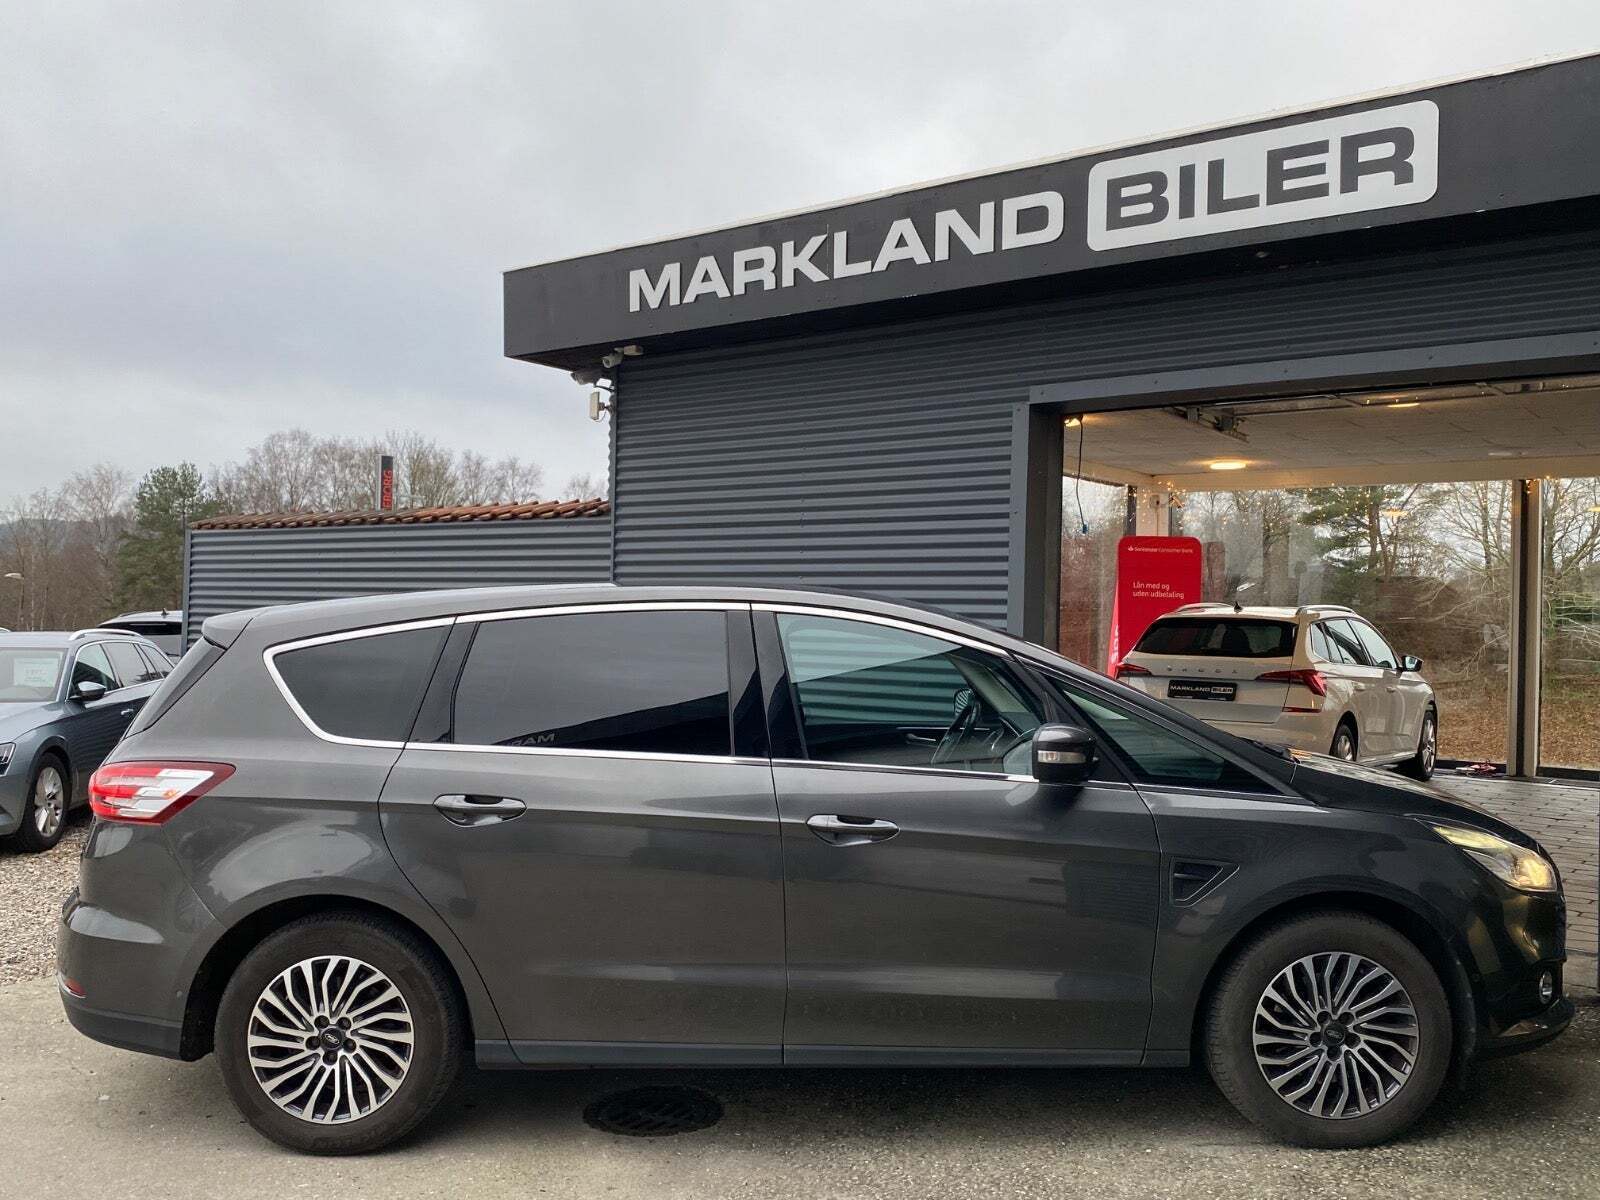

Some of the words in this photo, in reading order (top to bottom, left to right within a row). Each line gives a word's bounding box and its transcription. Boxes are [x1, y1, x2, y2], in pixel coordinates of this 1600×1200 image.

[629, 191, 1065, 313] MARKLAND
[1105, 126, 1415, 231] BILER
[1132, 581, 1145, 589] Lån
[1161, 583, 1170, 591] og
[1150, 591, 1184, 600] udbetaling
